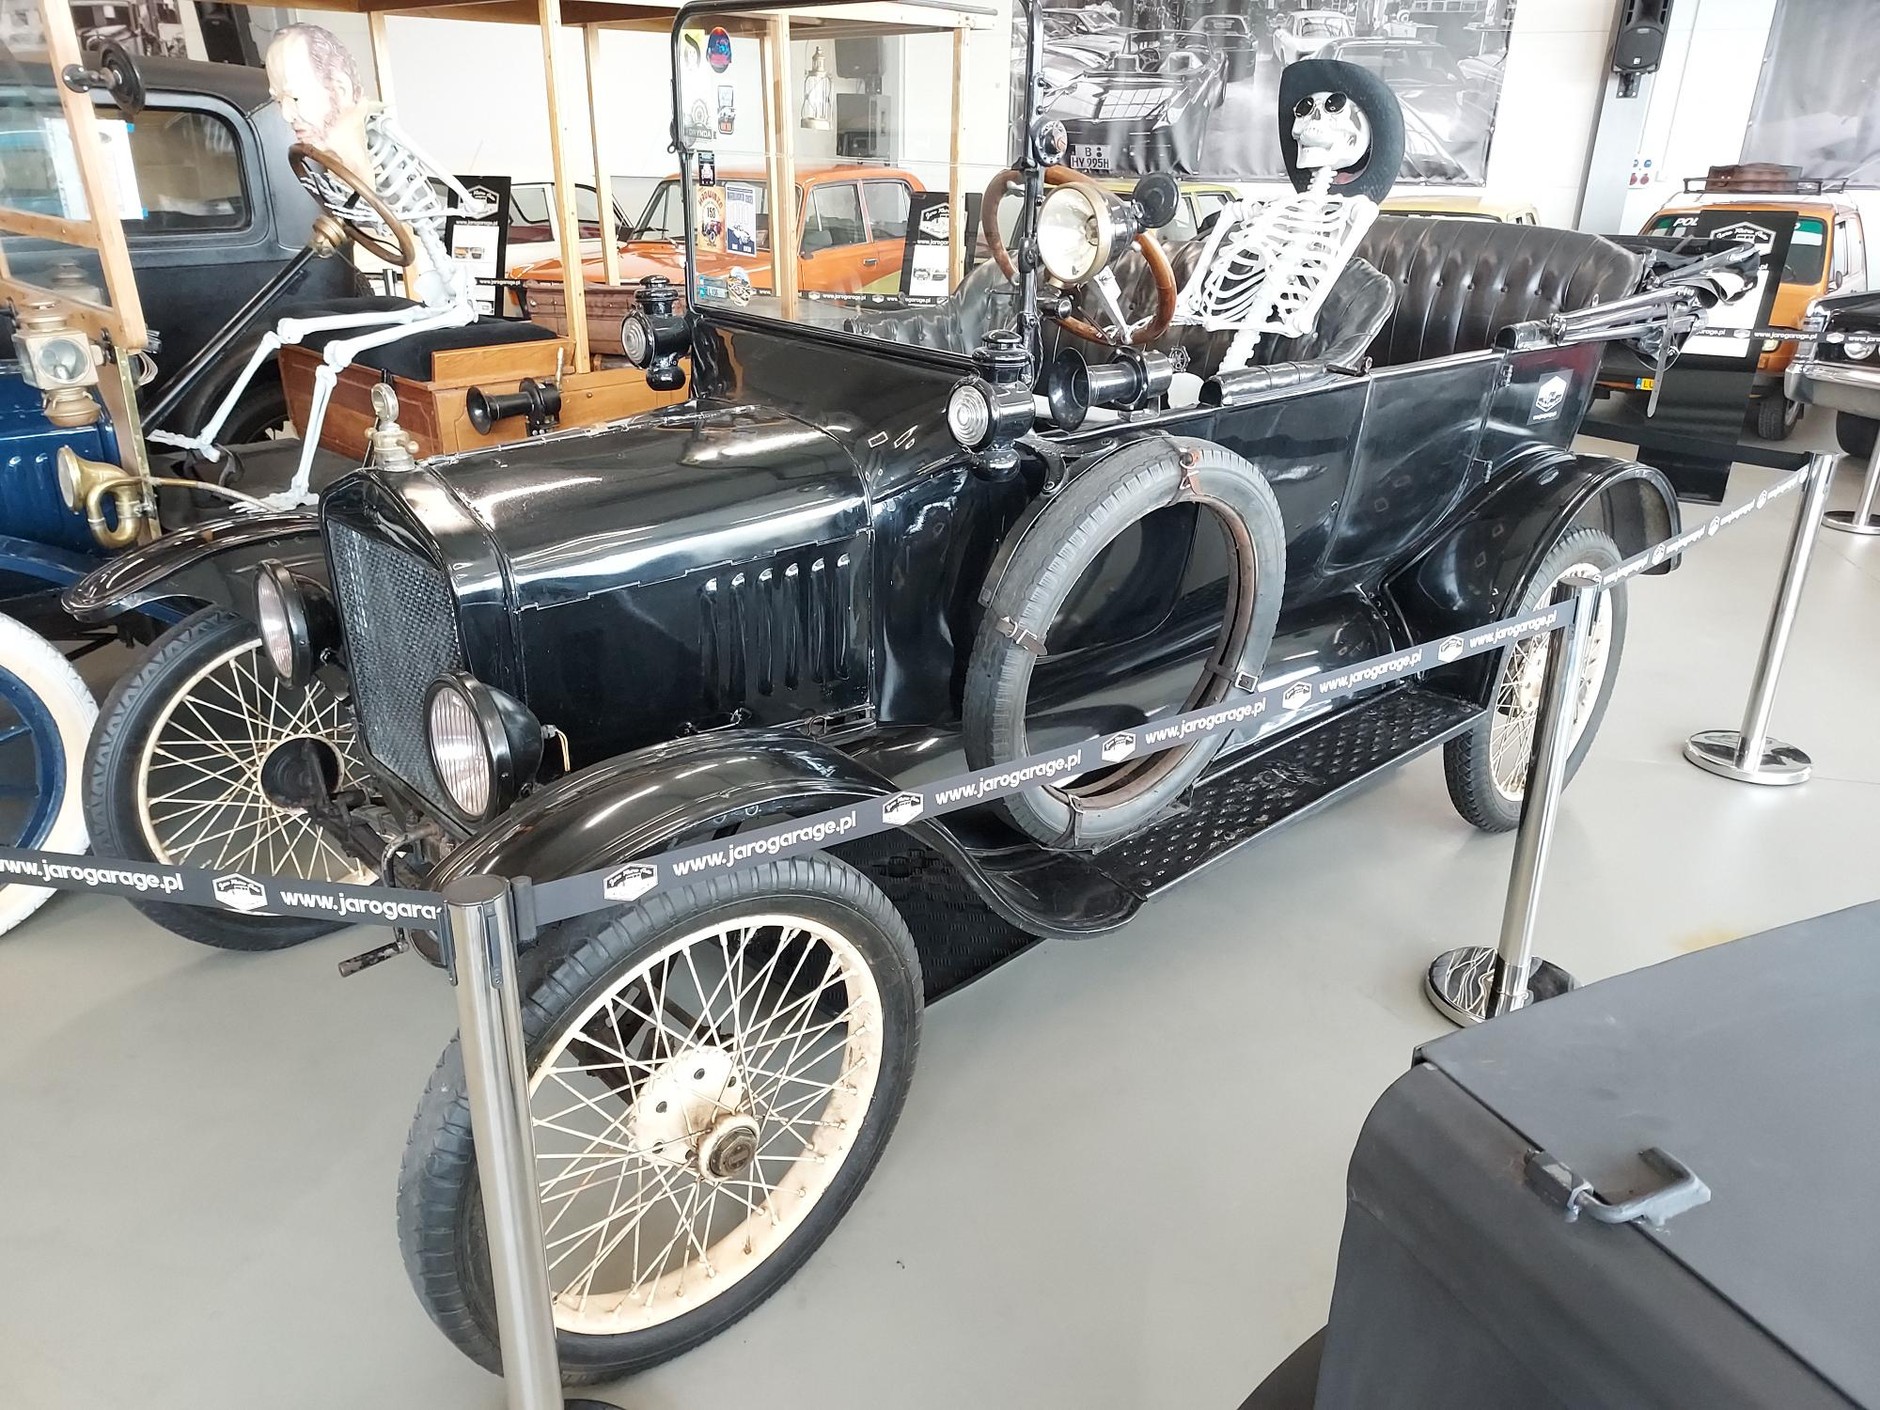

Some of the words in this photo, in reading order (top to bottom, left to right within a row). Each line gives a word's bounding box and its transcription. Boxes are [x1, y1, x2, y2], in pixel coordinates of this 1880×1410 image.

[1071, 157, 1085, 168] HY
[1085, 147, 1092, 157] B
[1469, 609, 1558, 648] www.jarogarage.pl
[1319, 648, 1423, 694] www.jarogarage.pl
[1145, 697, 1267, 744] www.jarogarage.pl
[935, 749, 1082, 805] www.jarogarage.pl
[672, 811, 857, 877] www.jarogarage.pl
[280, 891, 442, 920] www.jarogara
